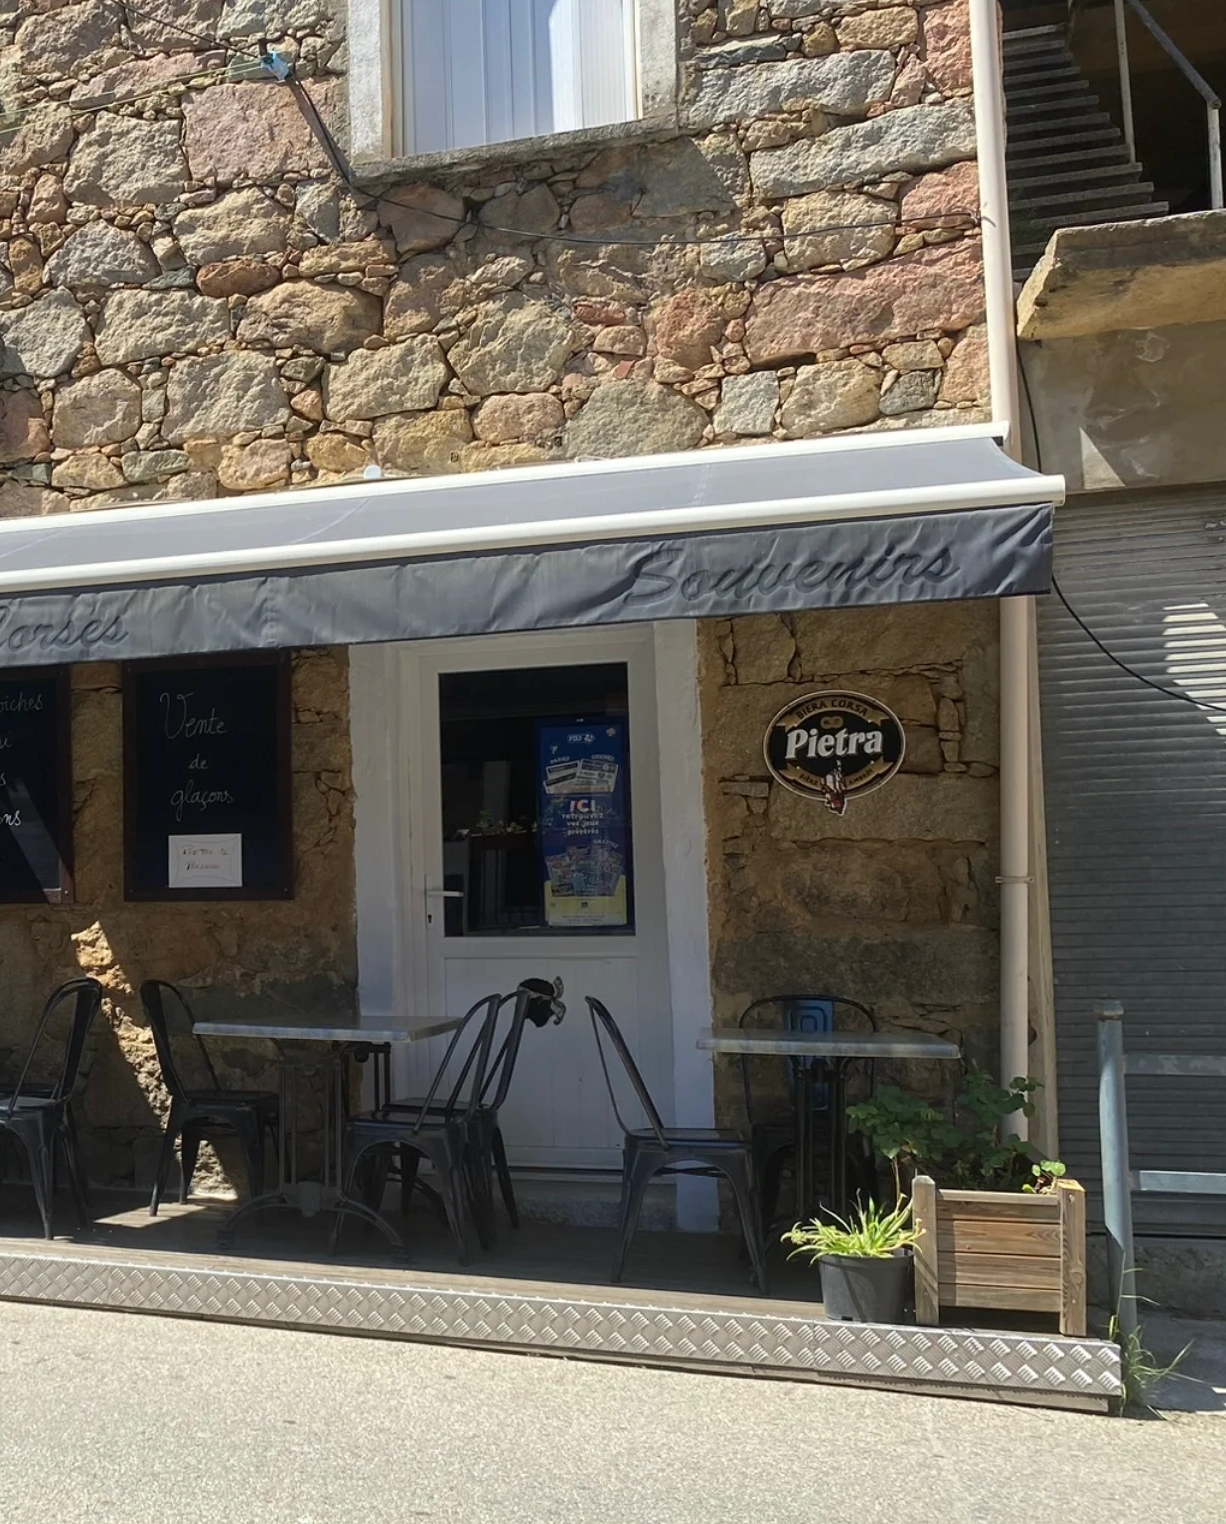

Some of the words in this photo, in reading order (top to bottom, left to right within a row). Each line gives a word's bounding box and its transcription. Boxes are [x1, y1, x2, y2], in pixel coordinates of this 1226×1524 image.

[621, 544, 962, 605] Souvenirs
[159, 692, 228, 739] Vente
[796, 700, 827, 720] BIERA
[831, 699, 868, 716] CORSA
[785, 728, 883, 759] Pietra
[188, 753, 210, 770] de
[170, 779, 234, 822] glaçons
[569, 799, 596, 813] ICI
[562, 812, 604, 820] retrouvez
